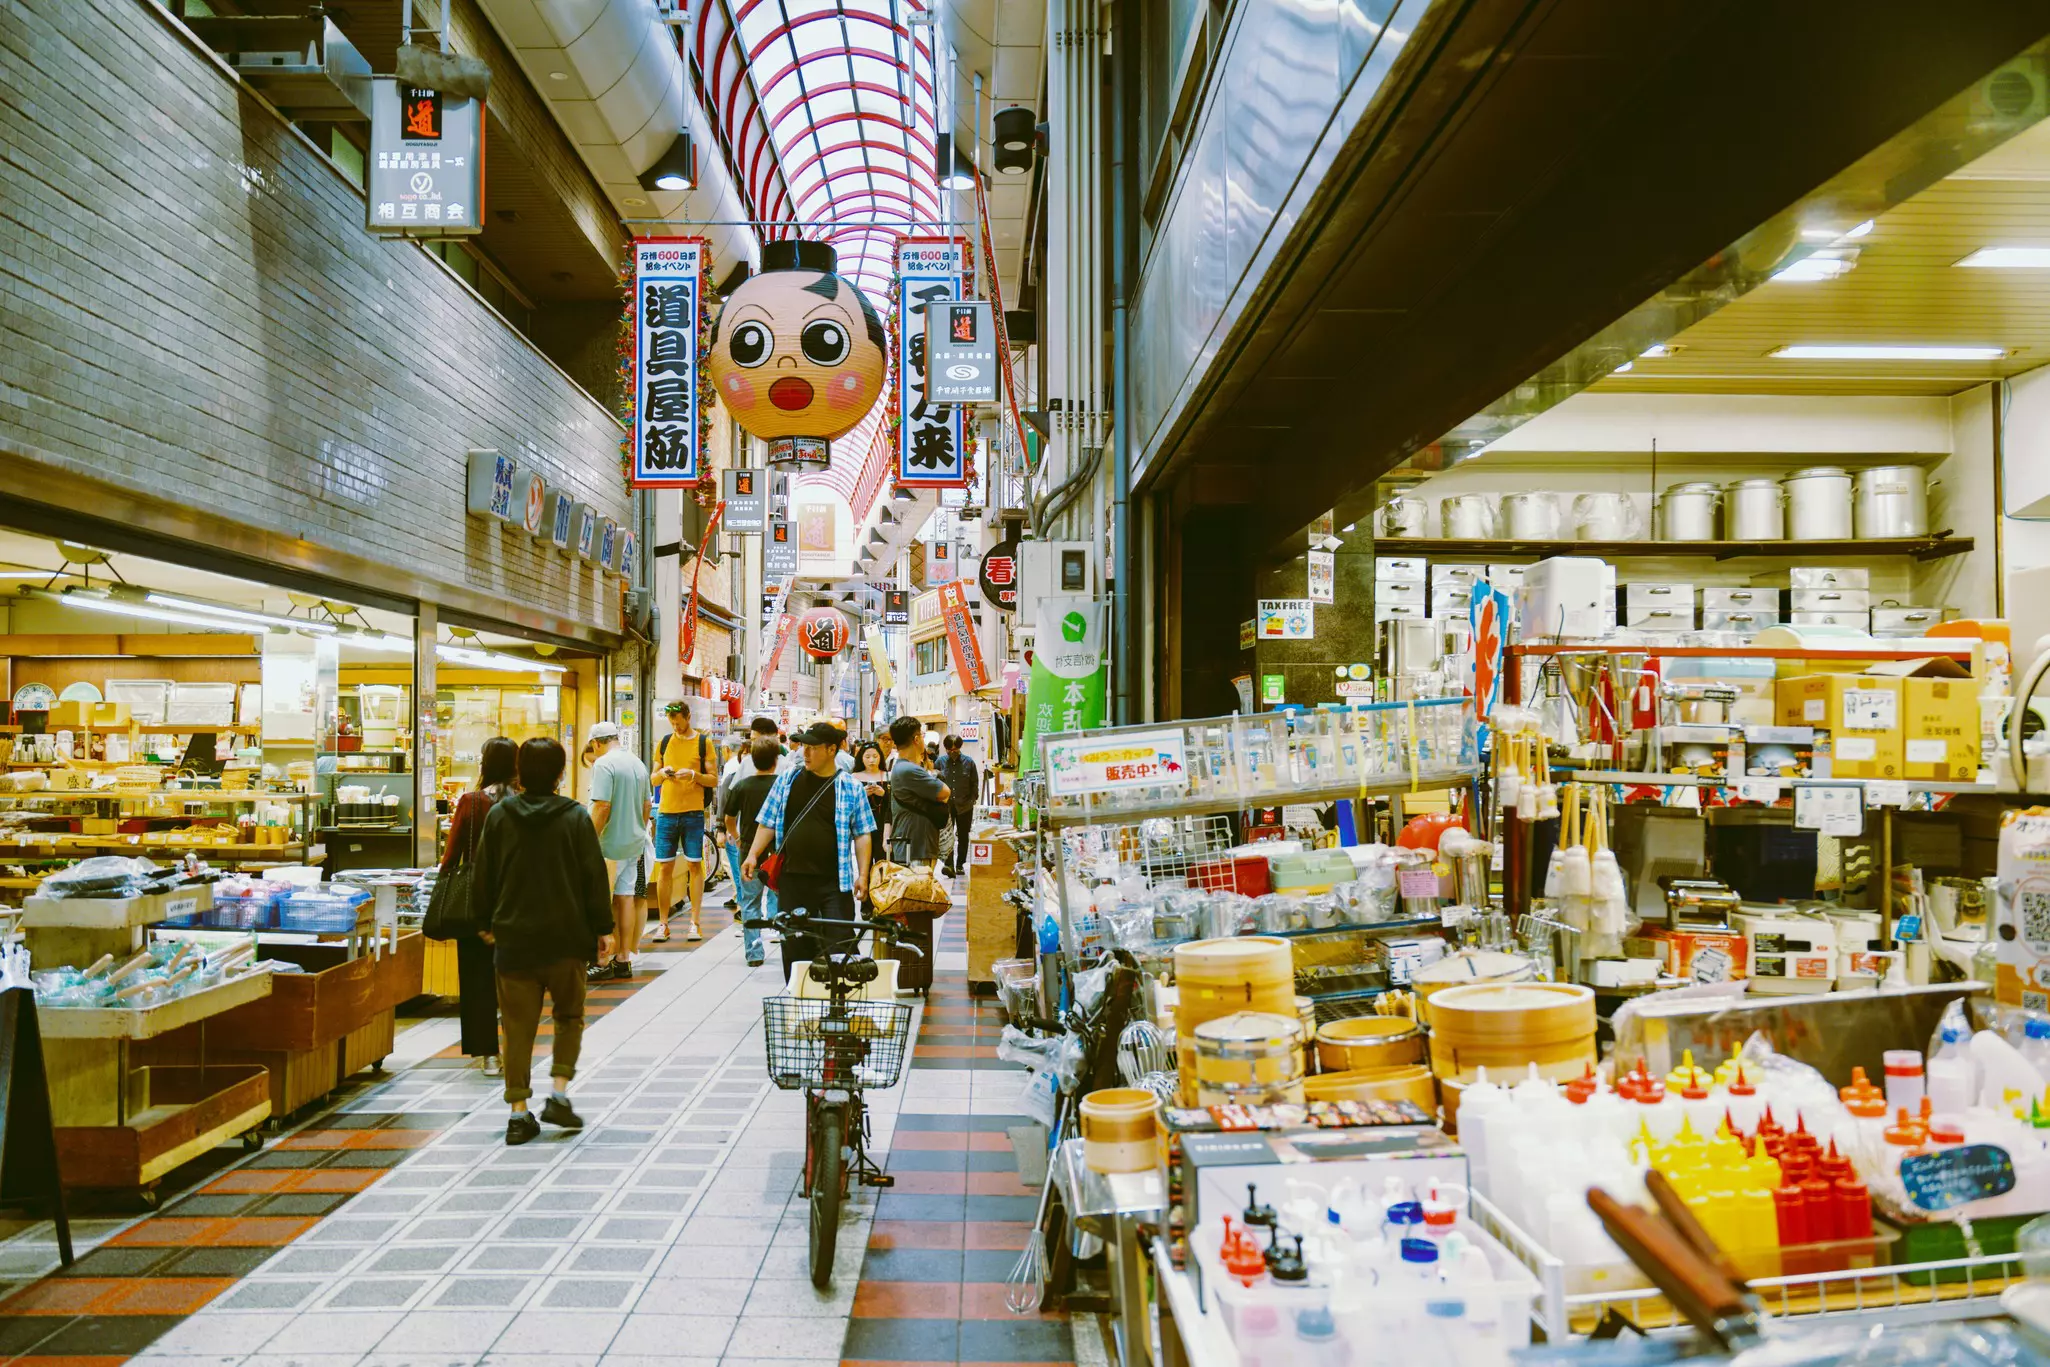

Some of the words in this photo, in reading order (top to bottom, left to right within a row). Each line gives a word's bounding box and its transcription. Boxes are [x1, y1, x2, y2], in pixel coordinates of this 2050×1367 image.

[411, 89, 434, 97] 千日前
[378, 202, 464, 220] 相互商会
[640, 251, 697, 261] 万博600日前
[645, 262, 691, 271] 記念イベント
[645, 284, 690, 470] 道具屋筋
[986, 556, 1017, 585] 看
[1261, 602, 1281, 610] TAX
[1282, 602, 1311, 610] FREE
